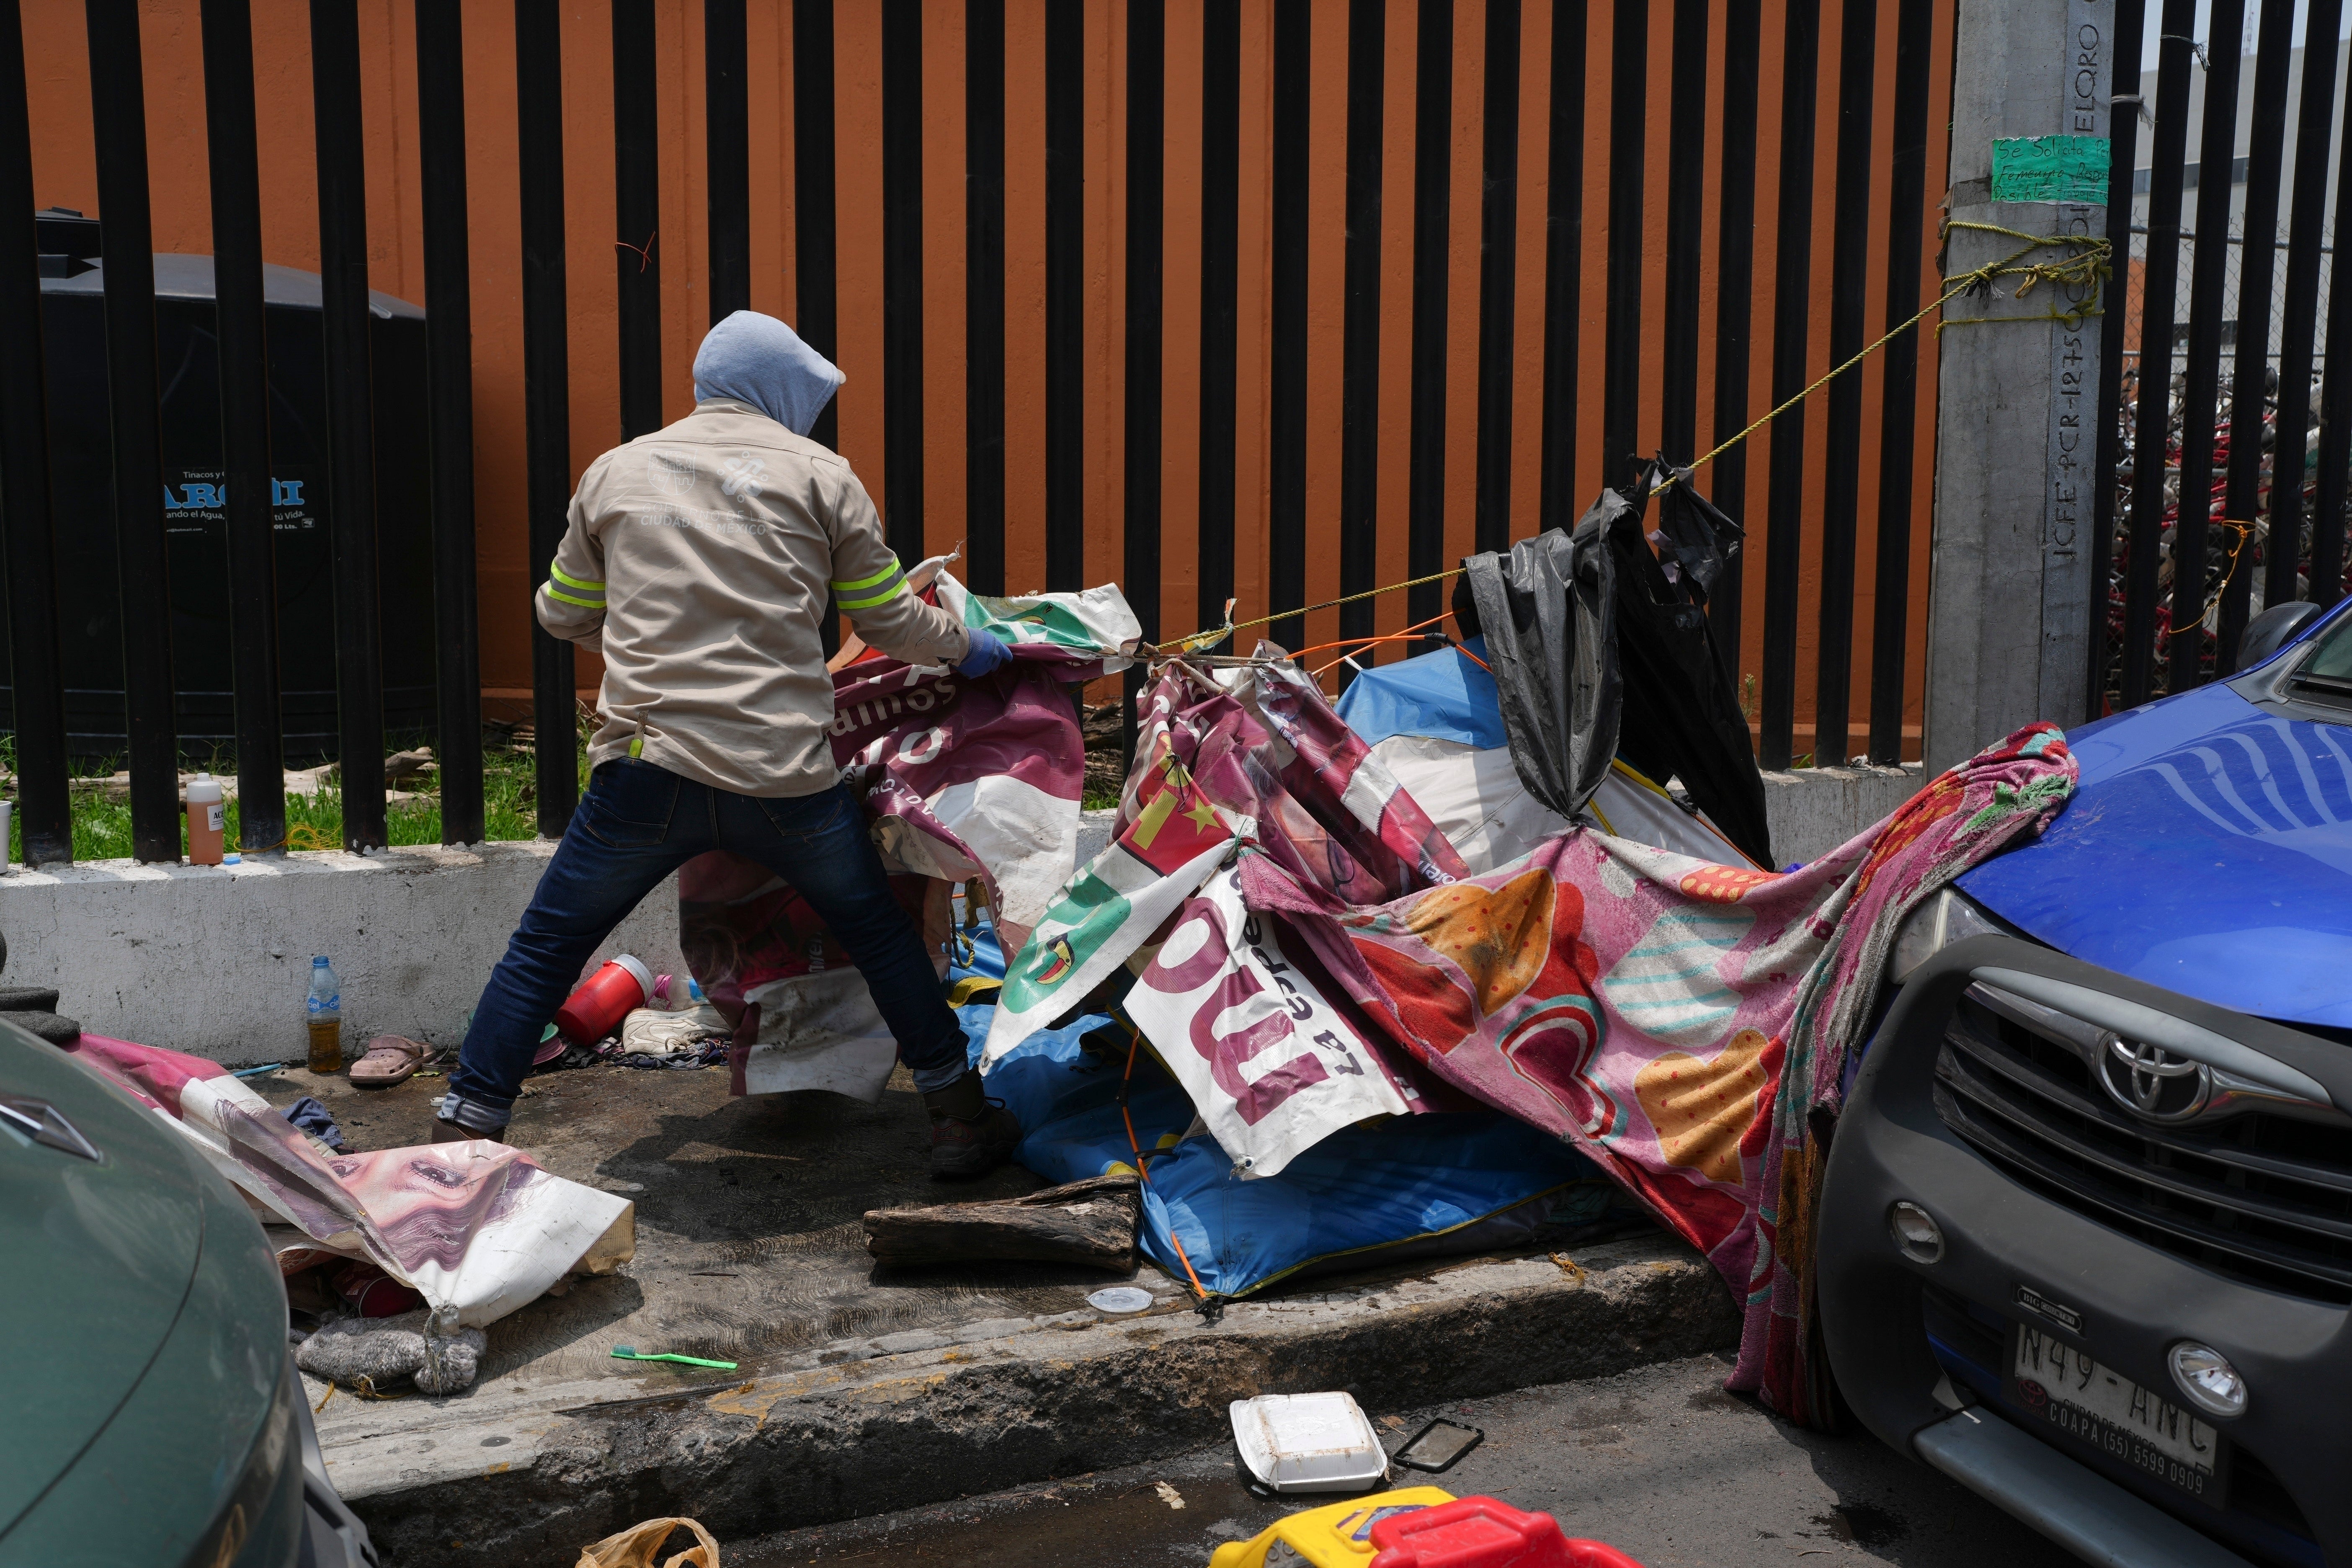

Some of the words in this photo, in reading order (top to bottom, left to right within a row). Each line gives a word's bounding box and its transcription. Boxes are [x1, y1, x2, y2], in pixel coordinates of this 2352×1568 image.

[1999, 139, 2024, 159] Se
[2032, 138, 2084, 157] Solicita
[1999, 165, 2064, 183] Femenino
[200, 511, 225, 520] Agua,
[274, 513, 284, 521] tú
[284, 510, 305, 520] Vida.
[642, 503, 720, 522] GOBIERNO
[726, 510, 745, 521] DE
[750, 510, 766, 522] LA
[641, 515, 691, 528] CIUDAD
[716, 520, 766, 536] MÉXICO
[308, 1000, 320, 1009] ciel
[2050, 1403, 2098, 1443] COAPA
[2104, 1429, 2128, 1459] (55)
[2135, 1445, 2165, 1475] 5599
[2170, 1462, 2202, 1494] 0909
